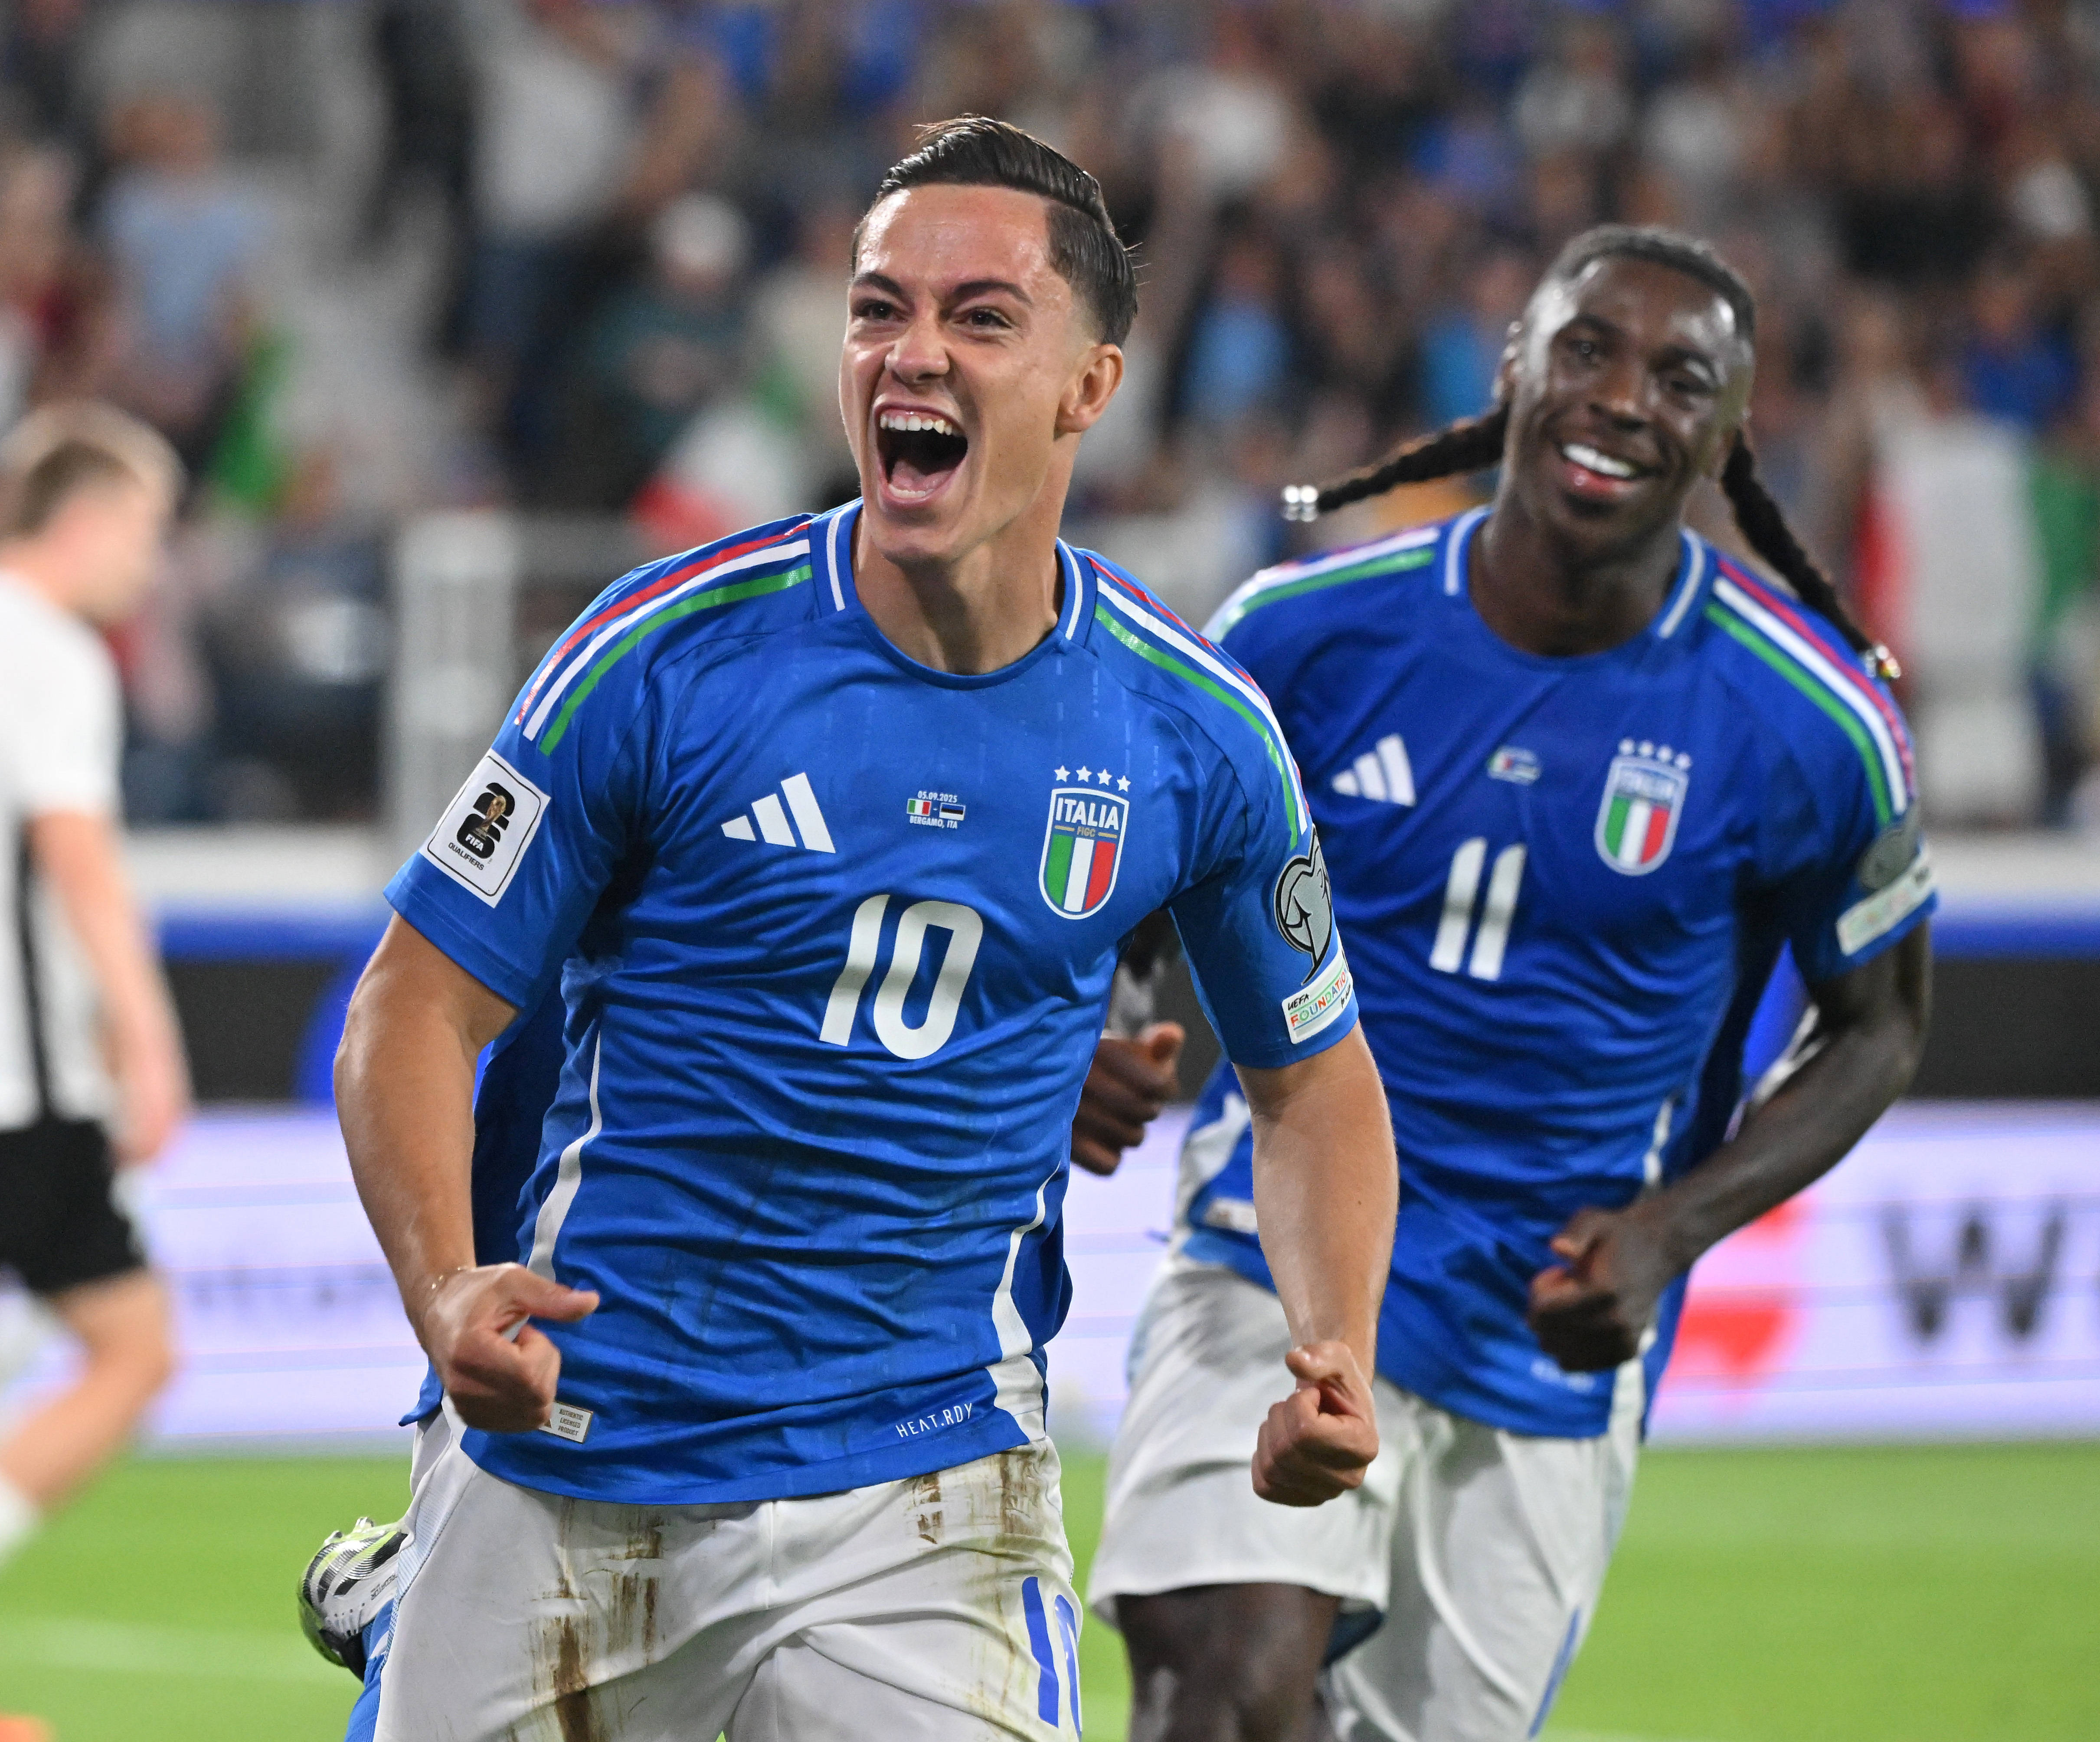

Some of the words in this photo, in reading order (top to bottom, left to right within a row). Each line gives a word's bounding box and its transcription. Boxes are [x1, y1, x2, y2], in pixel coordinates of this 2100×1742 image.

[917, 790, 958, 803] 05.09.2025
[909, 815, 945, 828] BERGAMO,
[946, 820, 958, 829] ITA
[1055, 797, 1119, 830] ITALIA
[1076, 826, 1096, 838] FIGC
[465, 834, 484, 851] FIFA
[448, 842, 484, 871] QUALIFIERS
[1429, 836, 1528, 982] 11
[819, 894, 984, 1060] 10
[1288, 993, 1309, 1011] UEFA
[1290, 968, 1346, 1027] FOUNDATIO
[559, 1408, 584, 1421] AUTHENTIC
[560, 1417, 581, 1428] LICENSED
[895, 1402, 972, 1438] HEAT.RDY
[558, 1425, 579, 1436] PRODUCT
